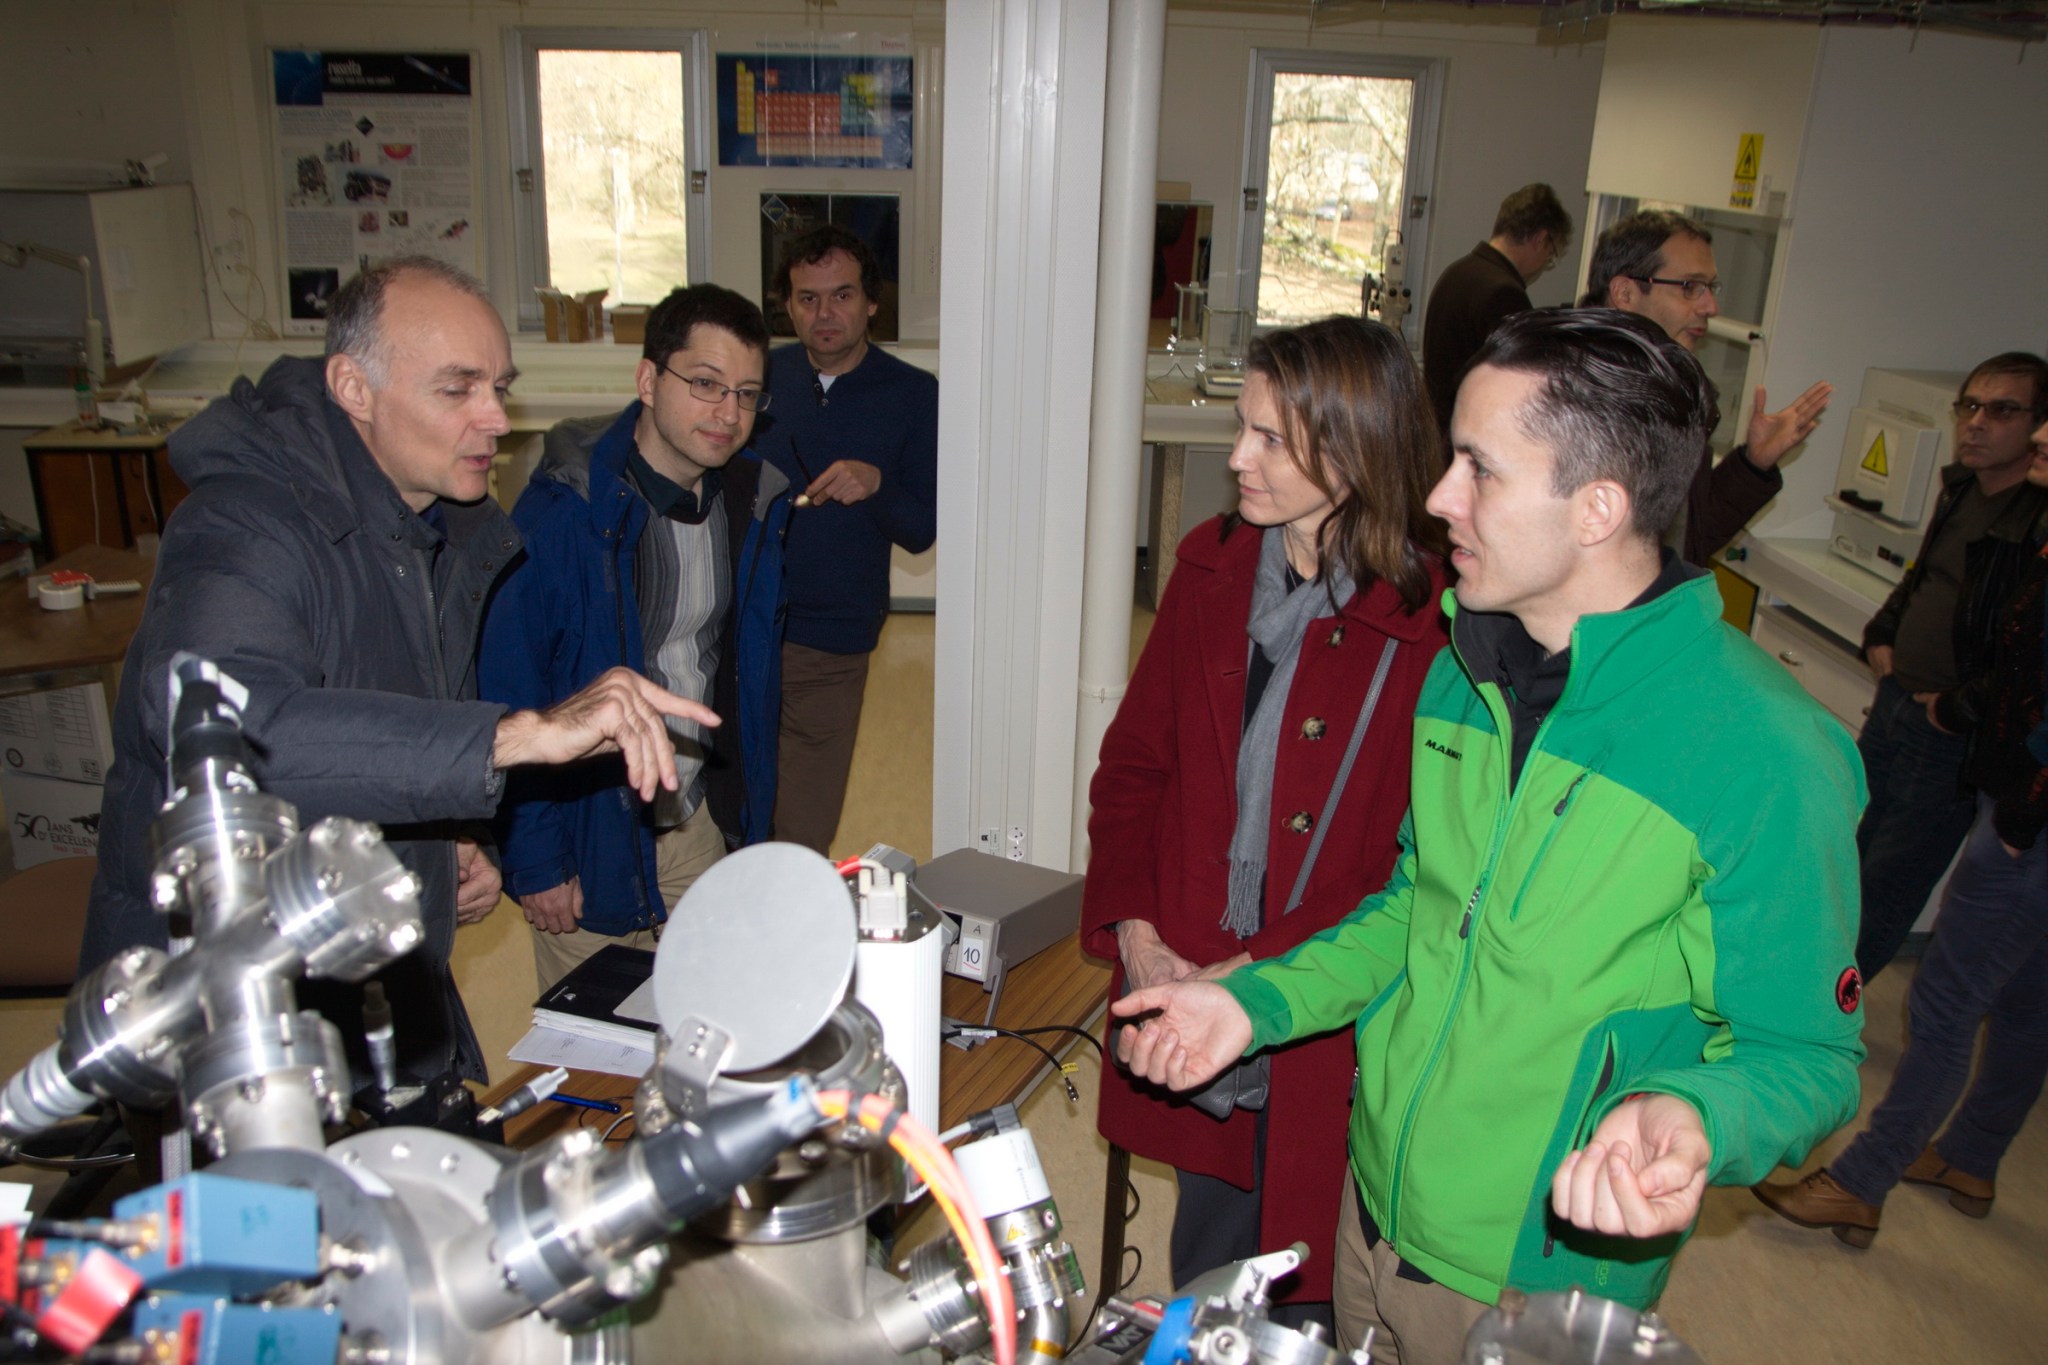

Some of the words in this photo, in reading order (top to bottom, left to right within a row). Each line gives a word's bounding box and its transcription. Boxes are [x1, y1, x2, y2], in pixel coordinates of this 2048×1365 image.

[14, 812, 51, 839] 50
[51, 822, 74, 834] ANS
[972, 924, 982, 935] A
[963, 946, 981, 965] 10
